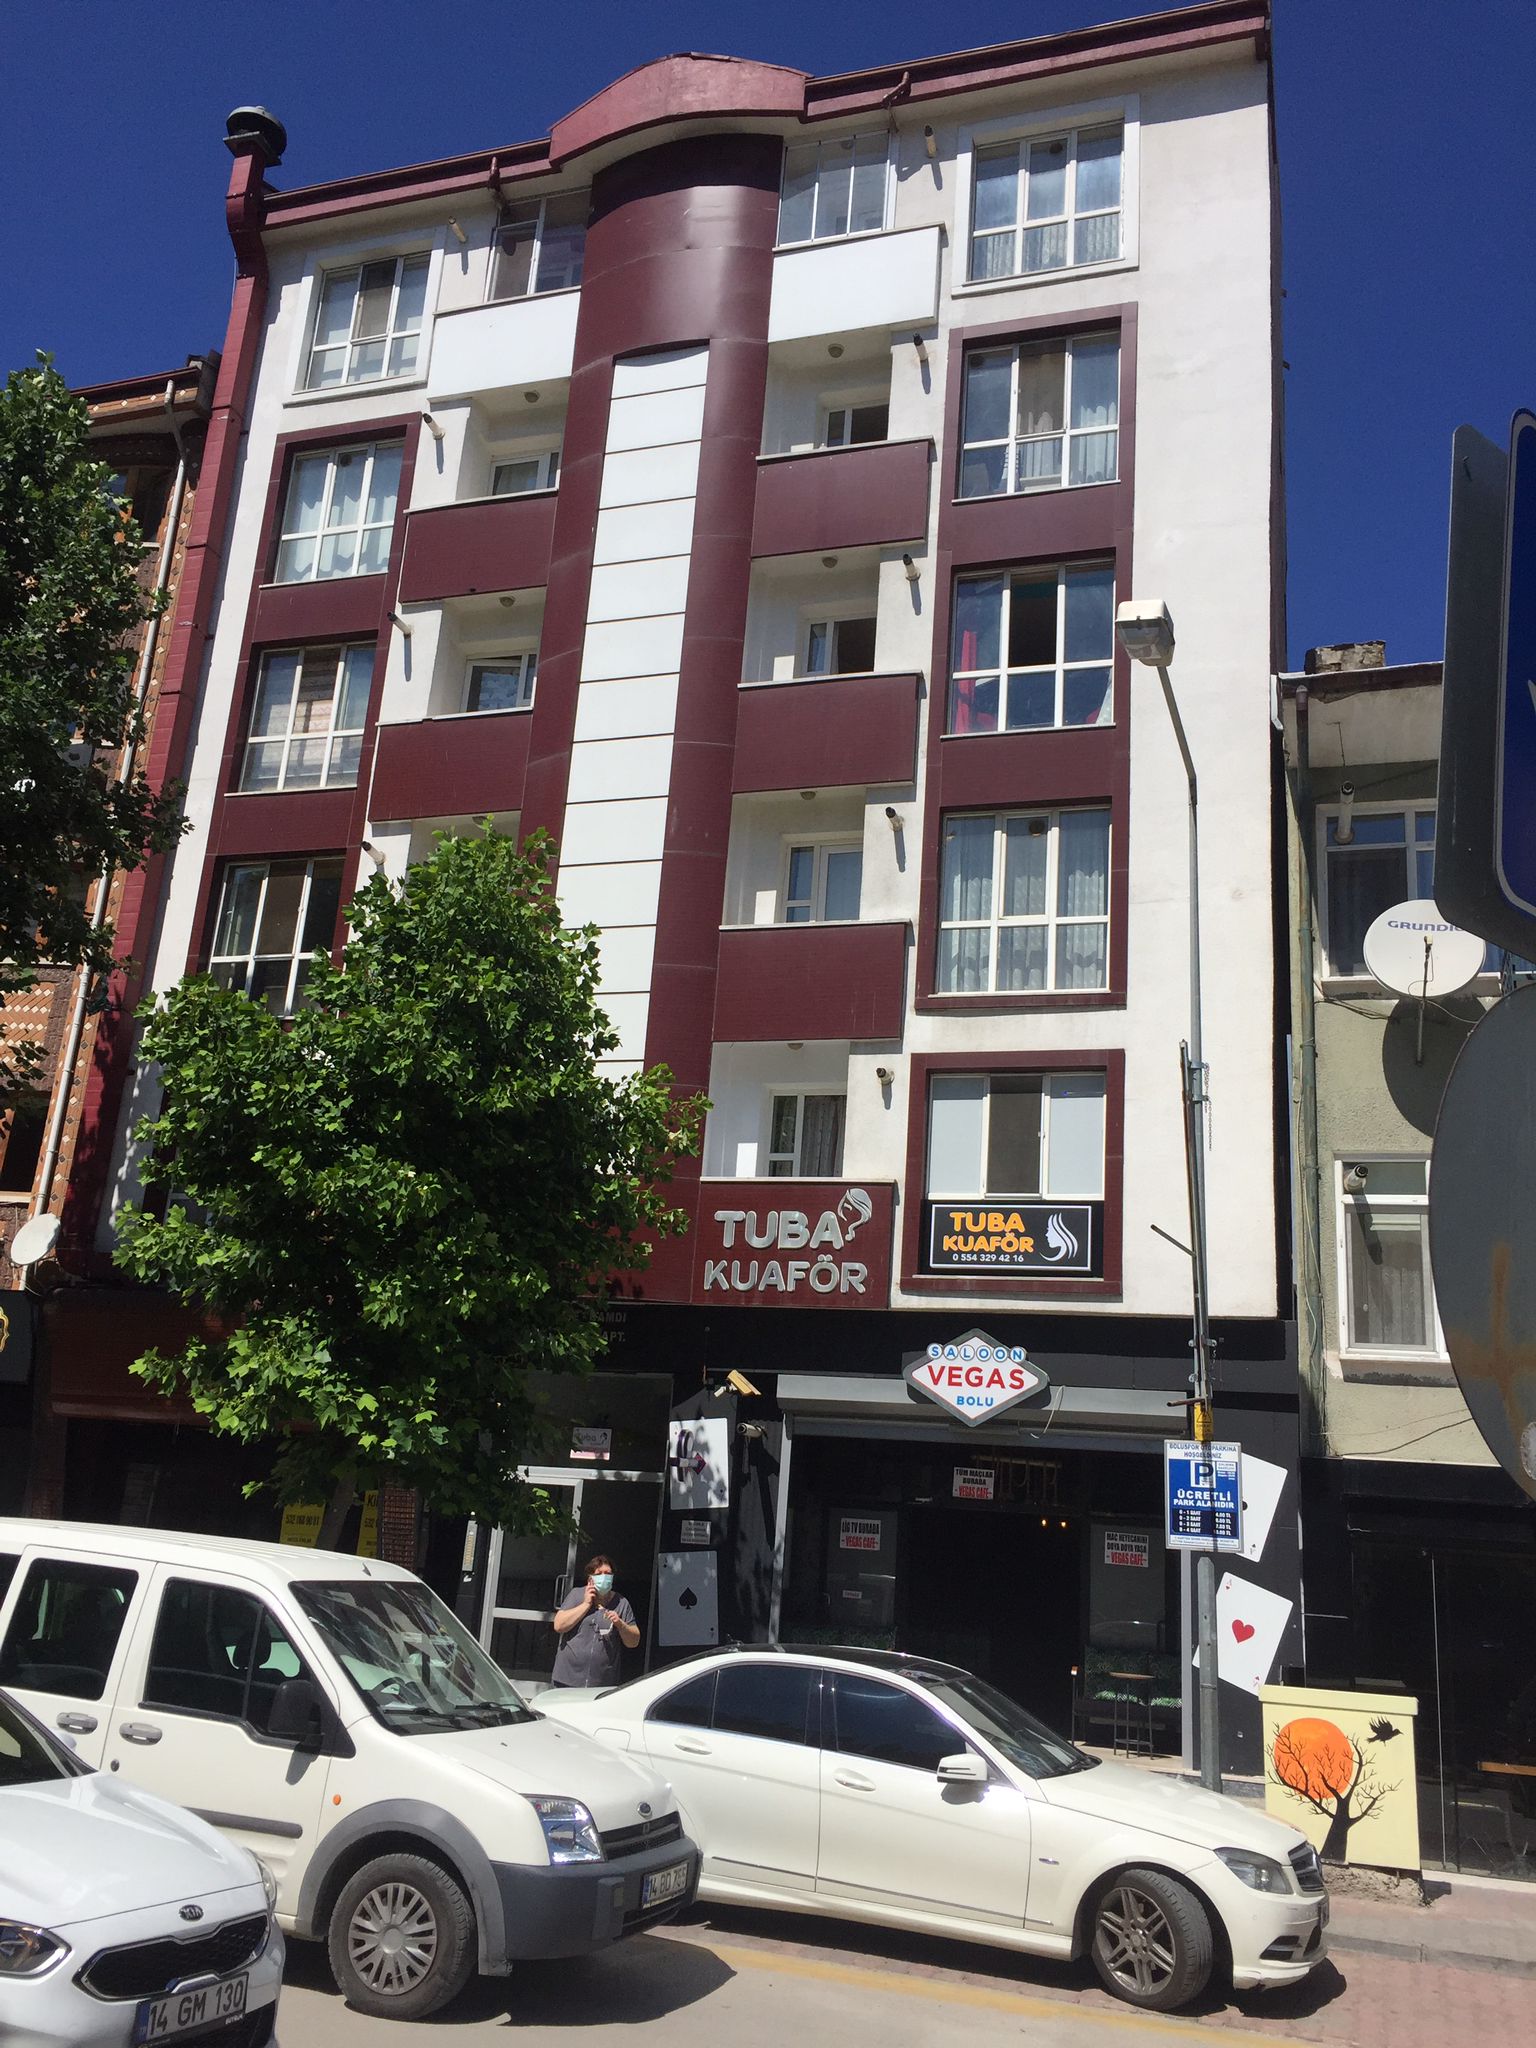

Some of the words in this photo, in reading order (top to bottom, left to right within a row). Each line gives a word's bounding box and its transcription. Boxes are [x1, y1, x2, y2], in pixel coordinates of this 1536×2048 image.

[714, 1210, 845, 1250] TUBA
[949, 1211, 1026, 1233] TUBA
[942, 1232, 1034, 1253] KUAFÖR
[952, 1253, 958, 1262] 0
[960, 1253, 978, 1262] 554
[980, 1253, 996, 1262] 329
[997, 1254, 1010, 1262] 42
[1012, 1254, 1024, 1263] 16
[703, 1254, 868, 1294] KUAFÖR
[930, 1344, 1024, 1361] SALOON
[927, 1365, 1025, 1390] VEGAS
[956, 1395, 994, 1407] BOLU
[1173, 1499, 1195, 1507] PARK
[1196, 1500, 1235, 1509] ALANIDIR
[180, 1905, 203, 1920] KIA
[149, 2002, 168, 2036] 14
[177, 1991, 207, 2027] GM
[215, 1980, 244, 2015] 130
